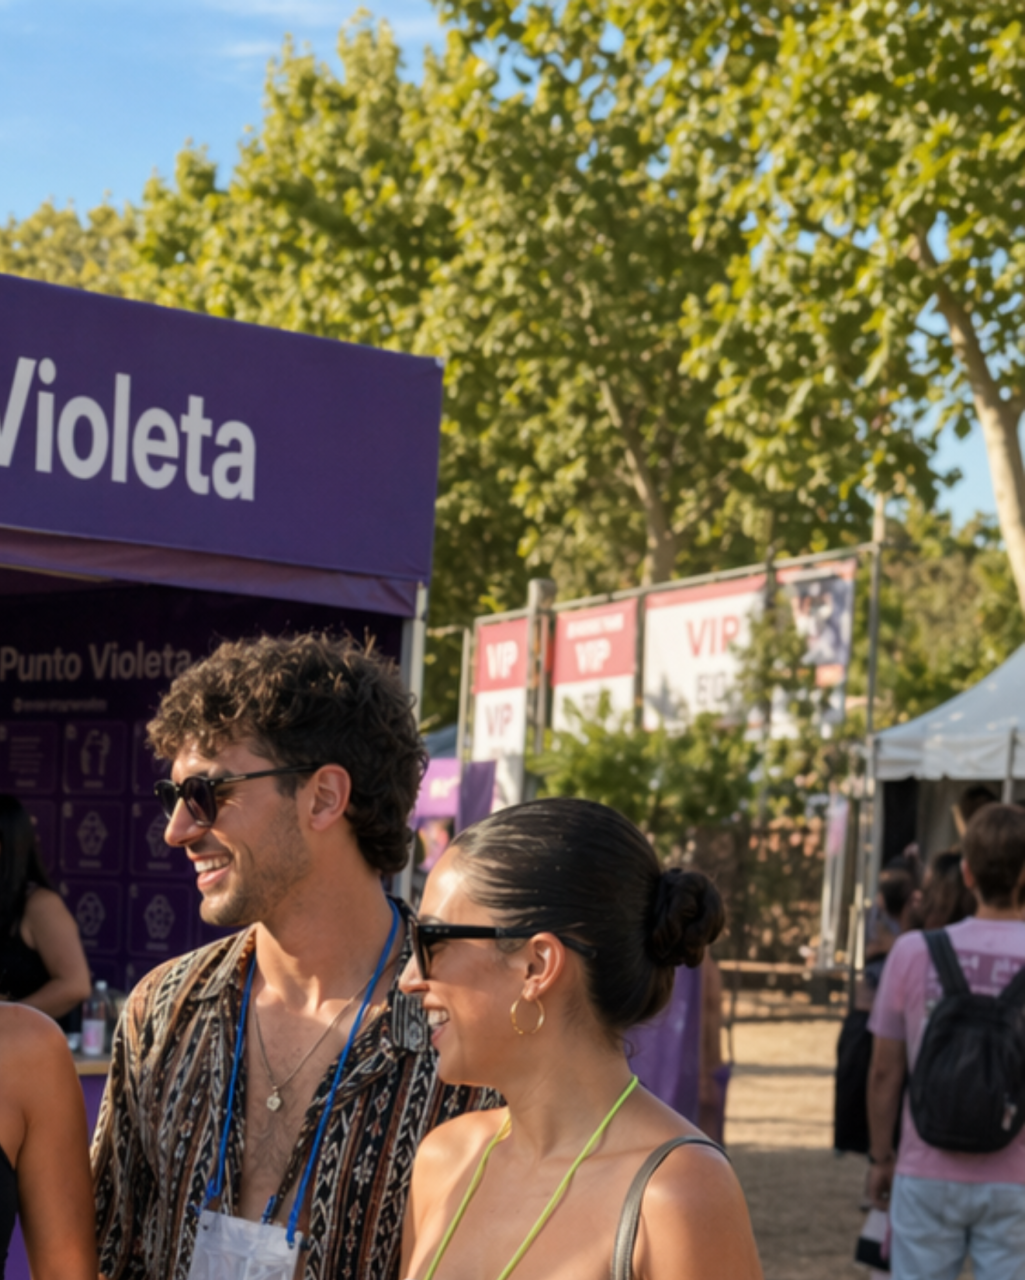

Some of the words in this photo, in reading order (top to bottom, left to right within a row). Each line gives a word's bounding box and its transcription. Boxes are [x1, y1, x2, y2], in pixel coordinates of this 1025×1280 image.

[687, 614, 740, 657] VIP
[89, 640, 193, 681] Violeta
[486, 641, 518, 680] VIP
[574, 638, 611, 674] VIP
